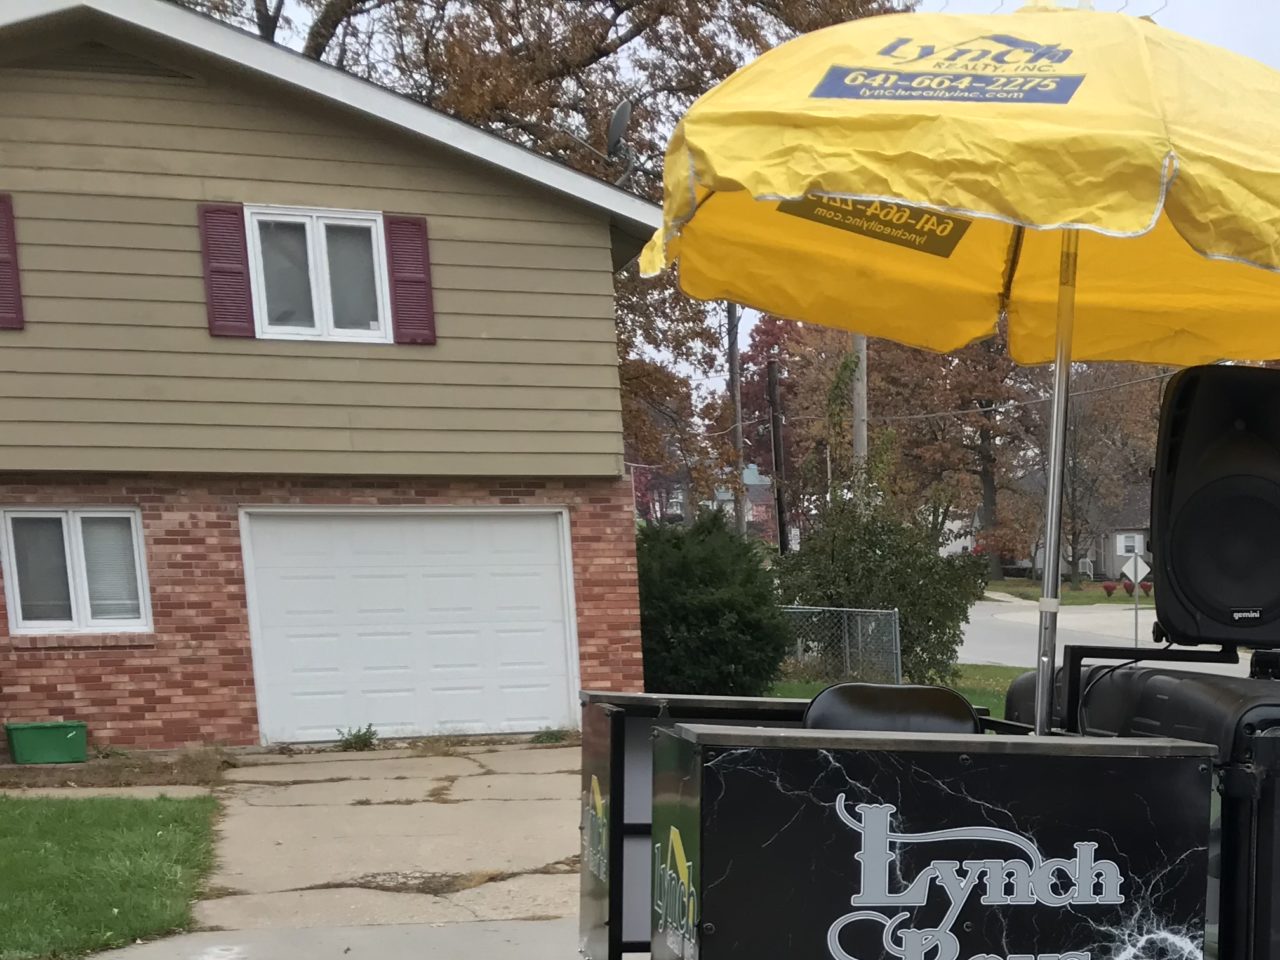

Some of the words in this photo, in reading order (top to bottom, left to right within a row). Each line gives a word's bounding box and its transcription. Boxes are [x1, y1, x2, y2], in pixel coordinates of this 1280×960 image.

[877, 35, 1074, 64] Lynch
[1014, 64, 1056, 73] INC.
[843, 71, 1061, 91] 641-664-2275
[860, 87, 1025, 99] lynchrealtyinc.com
[1233, 610, 1260, 620] gemini
[836, 793, 1125, 934] Lynch
